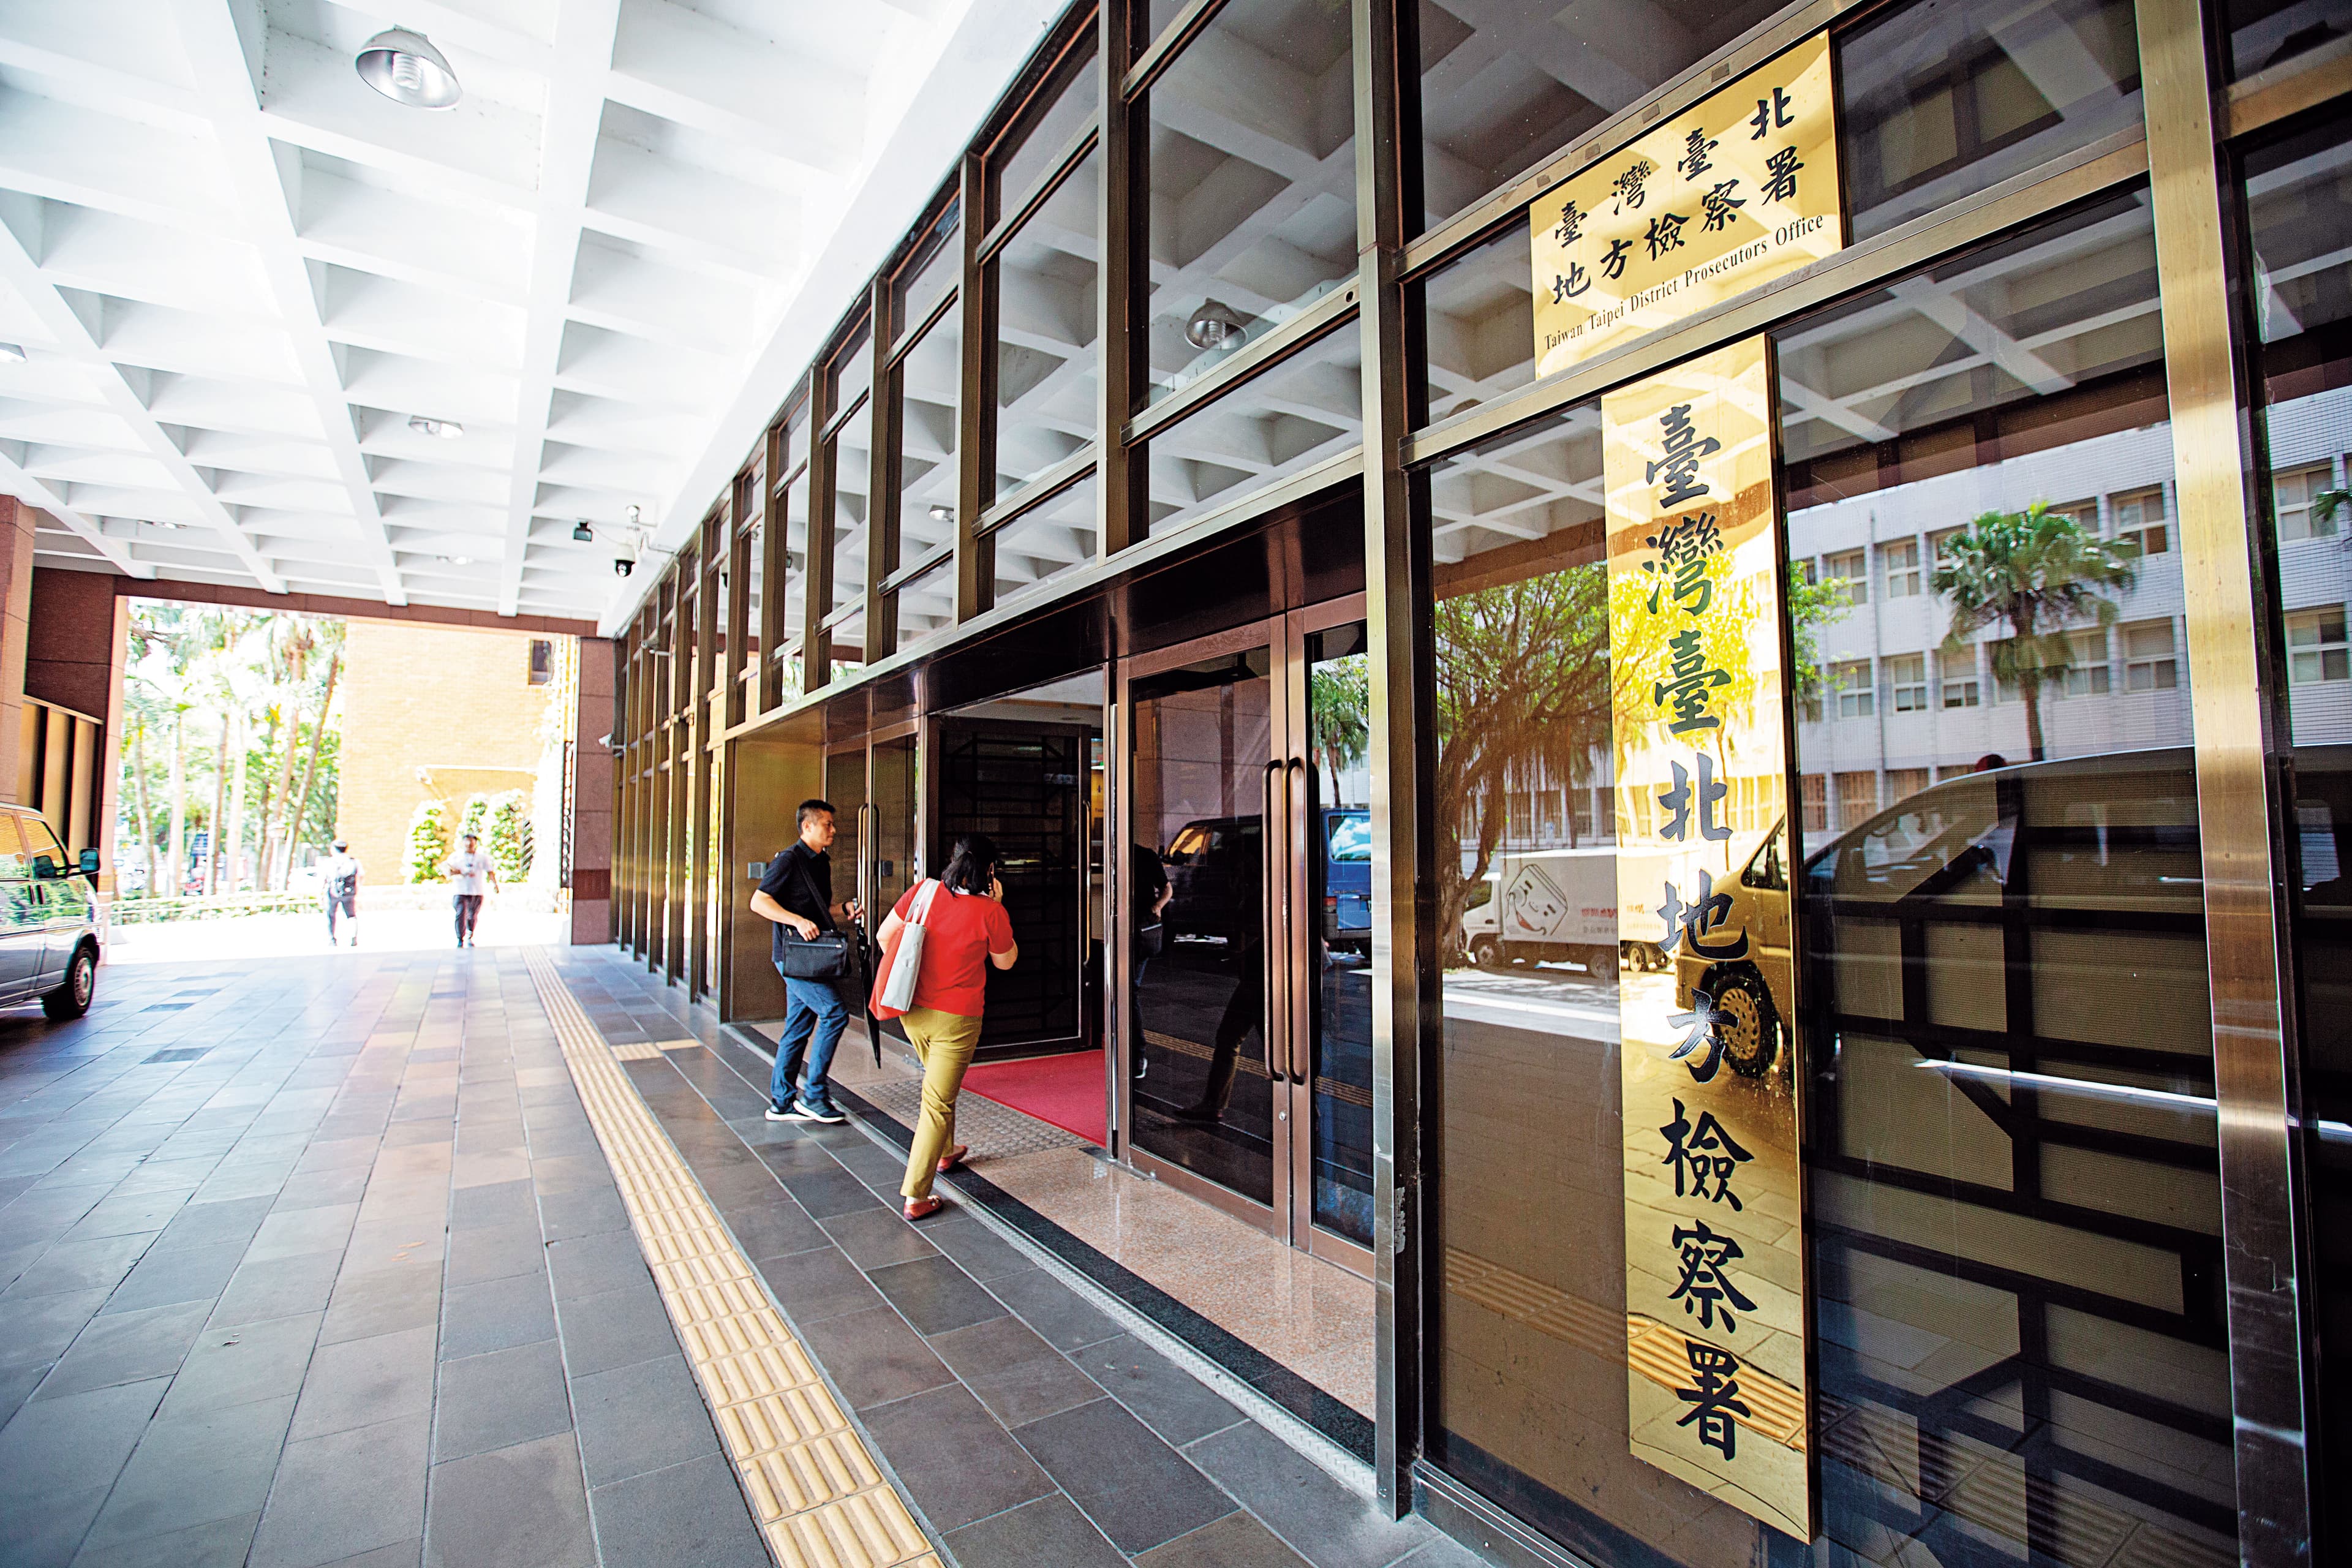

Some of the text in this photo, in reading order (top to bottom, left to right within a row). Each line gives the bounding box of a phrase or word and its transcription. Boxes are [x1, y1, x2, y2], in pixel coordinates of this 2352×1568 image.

[1553, 146, 1804, 304] 地方檢察署
[1555, 87, 1795, 248] 臺灣臺北
[1544, 215, 1823, 350] Taiwan Taipei District Prosecutors Office
[1642, 404, 1758, 1461] 臺灣臺北地方檢察署
